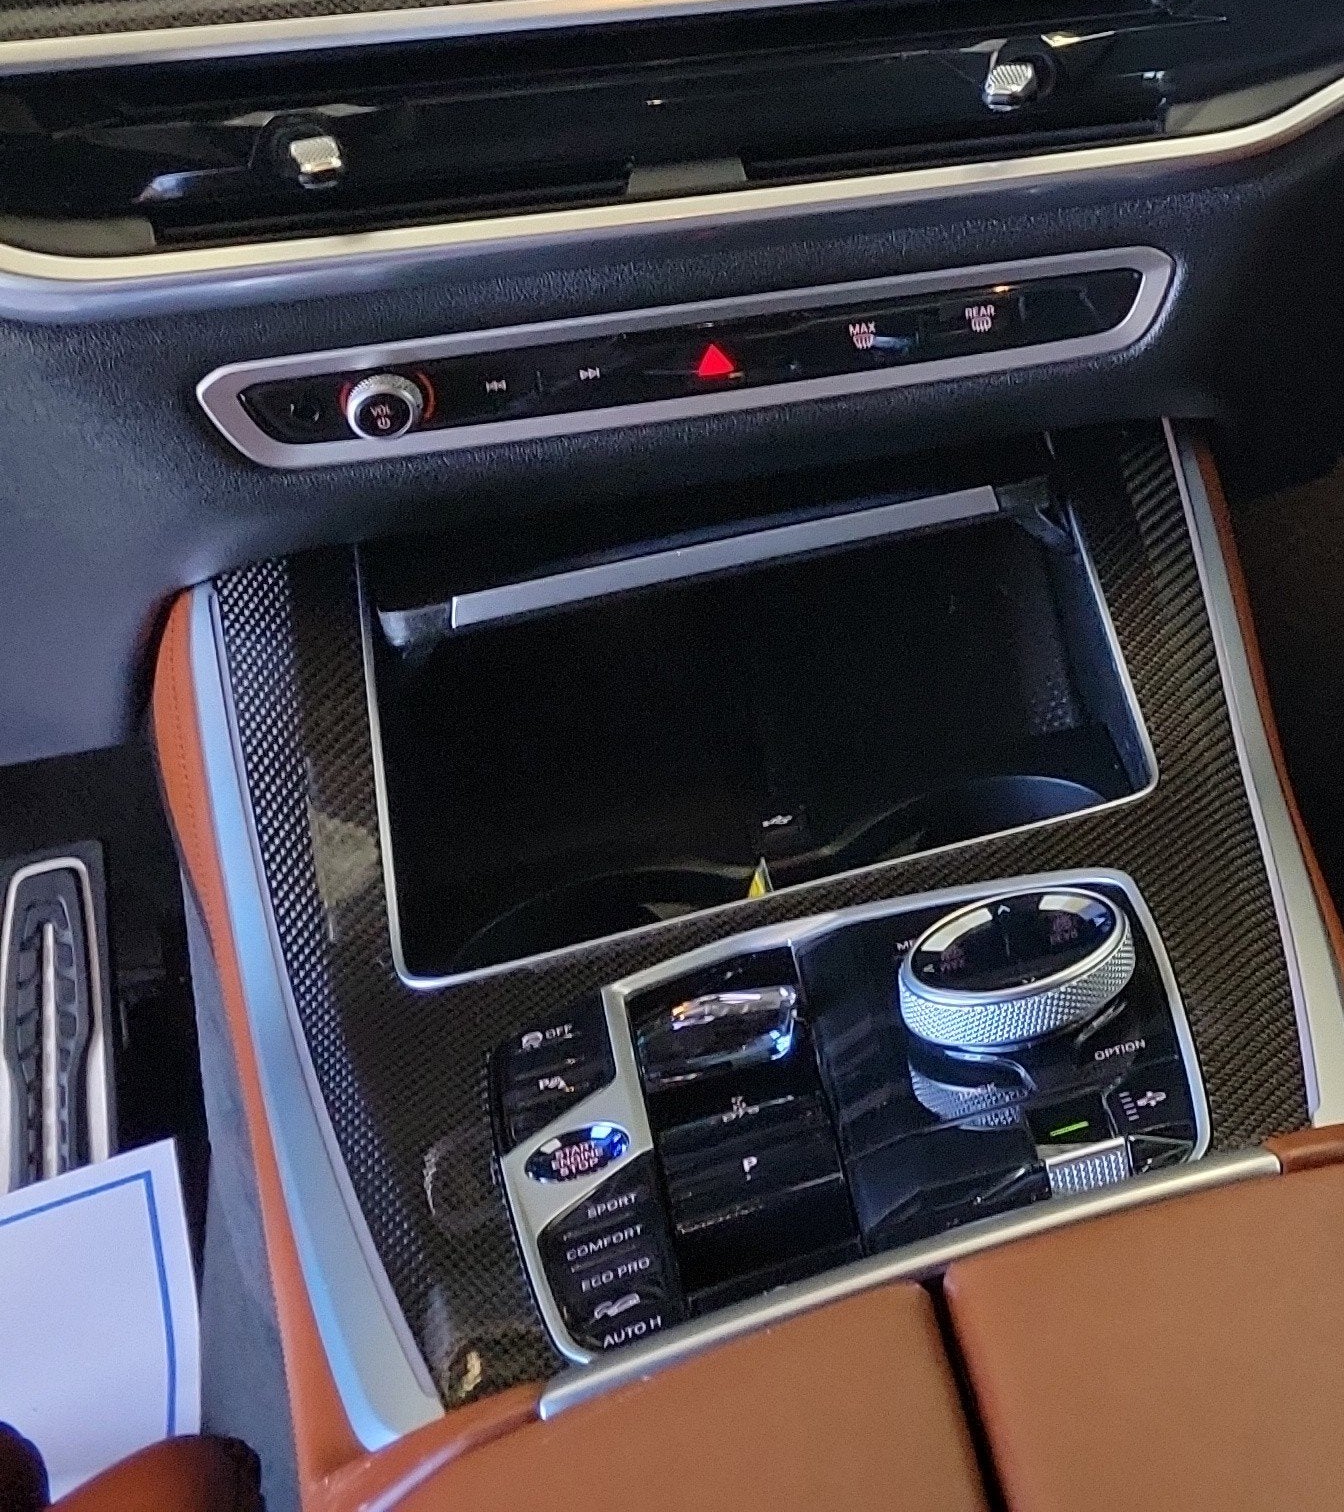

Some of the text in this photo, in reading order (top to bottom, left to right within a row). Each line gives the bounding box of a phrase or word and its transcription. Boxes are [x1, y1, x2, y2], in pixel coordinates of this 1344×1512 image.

[965, 304, 995, 320] REAR
[849, 321, 875, 336] MAX
[1094, 1039, 1146, 1061] OPTION
[742, 1156, 758, 1173] P
[587, 1193, 637, 1219] SPORT
[566, 1224, 642, 1261] COMFORT
[581, 1256, 650, 1292] ECO PRO
[603, 1315, 662, 1349] AUTO H
